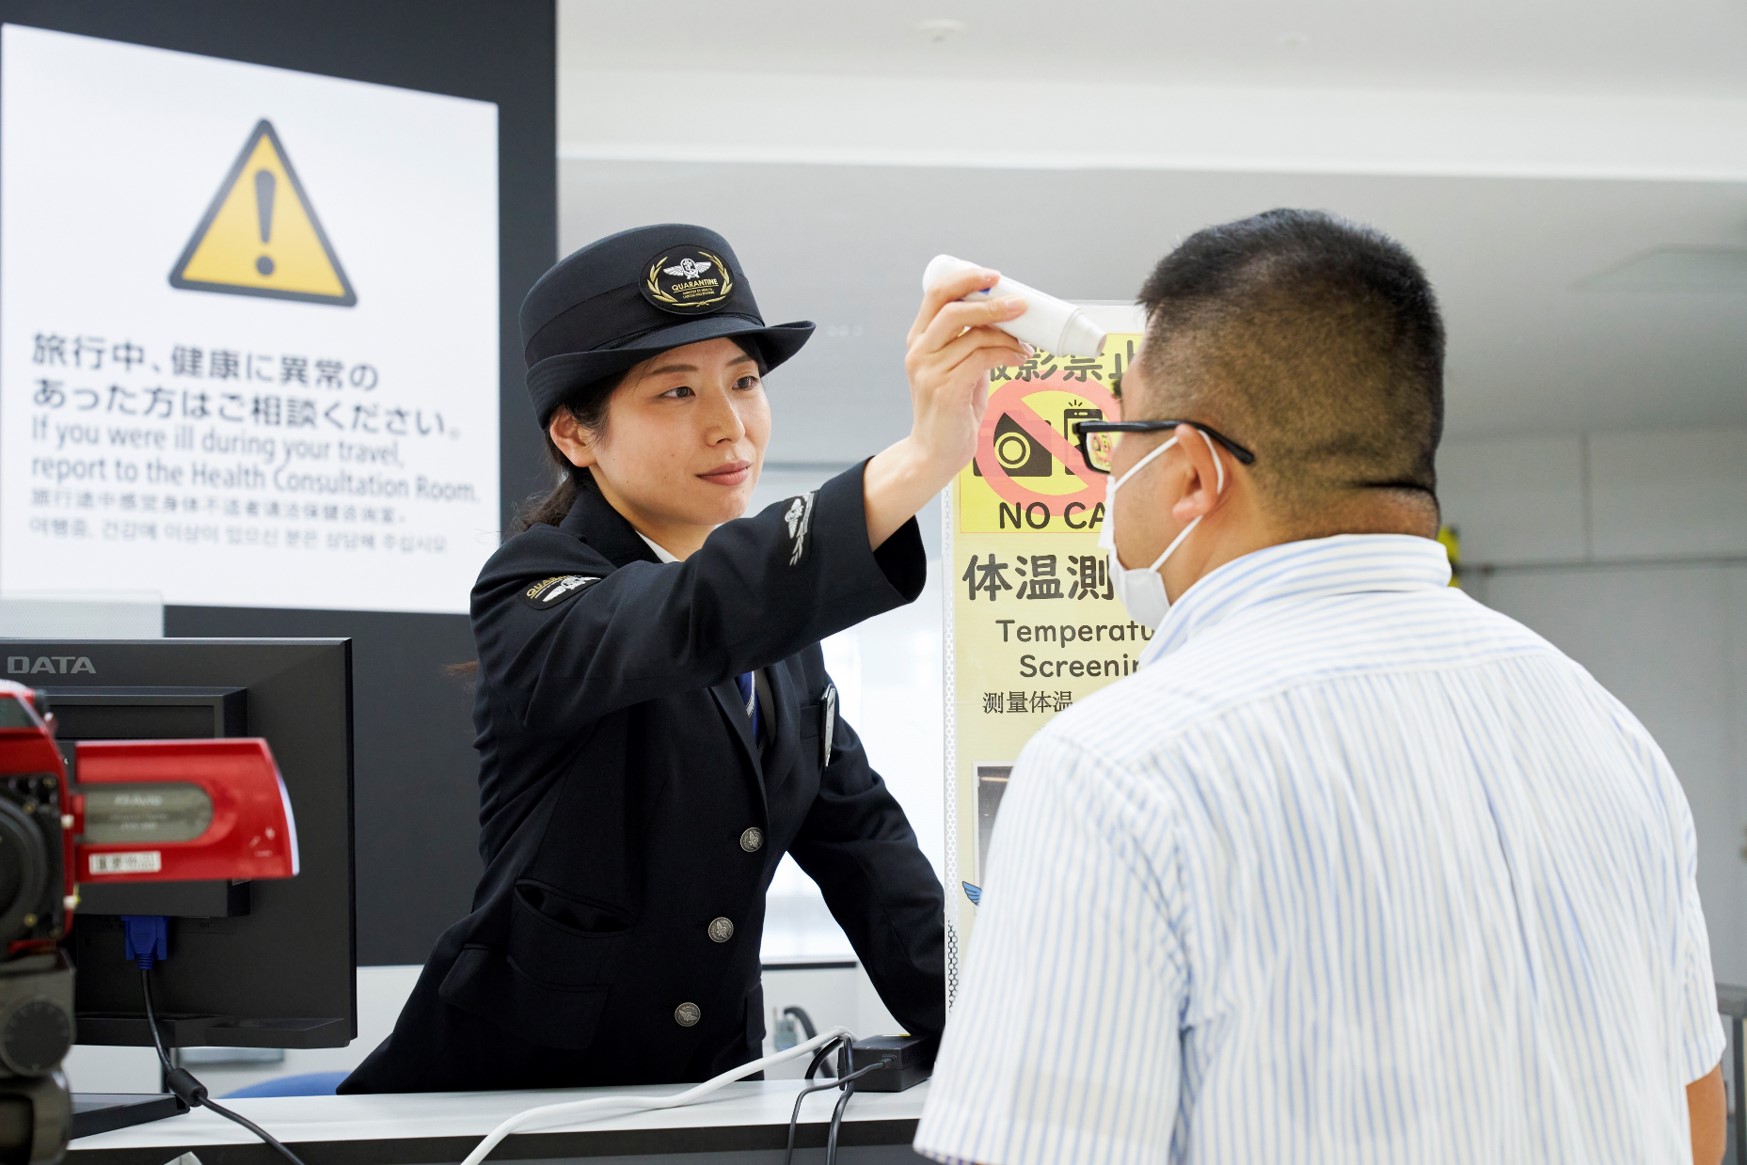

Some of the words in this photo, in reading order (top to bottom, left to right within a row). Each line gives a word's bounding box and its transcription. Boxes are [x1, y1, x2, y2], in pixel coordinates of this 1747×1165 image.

[671, 278, 719, 291] QUARANTINE
[32, 333, 379, 391] 旅行中、健康に異常の
[32, 378, 461, 440] あった方はご相談ください。
[32, 414, 48, 441] If
[55, 422, 100, 450] you
[107, 425, 166, 447] were
[174, 424, 194, 450] ill
[201, 426, 275, 465] during
[283, 437, 331, 468] your
[31, 456, 107, 485] report
[115, 458, 139, 482] to
[146, 457, 184, 486] the
[191, 460, 266, 490] Health
[273, 467, 410, 498] Consultation
[999, 501, 1051, 530] NO
[1063, 501, 1106, 530] CA
[962, 553, 1115, 602] 体温測
[7, 655, 97, 673] DATA
[982, 690, 1074, 715] 测量体温
